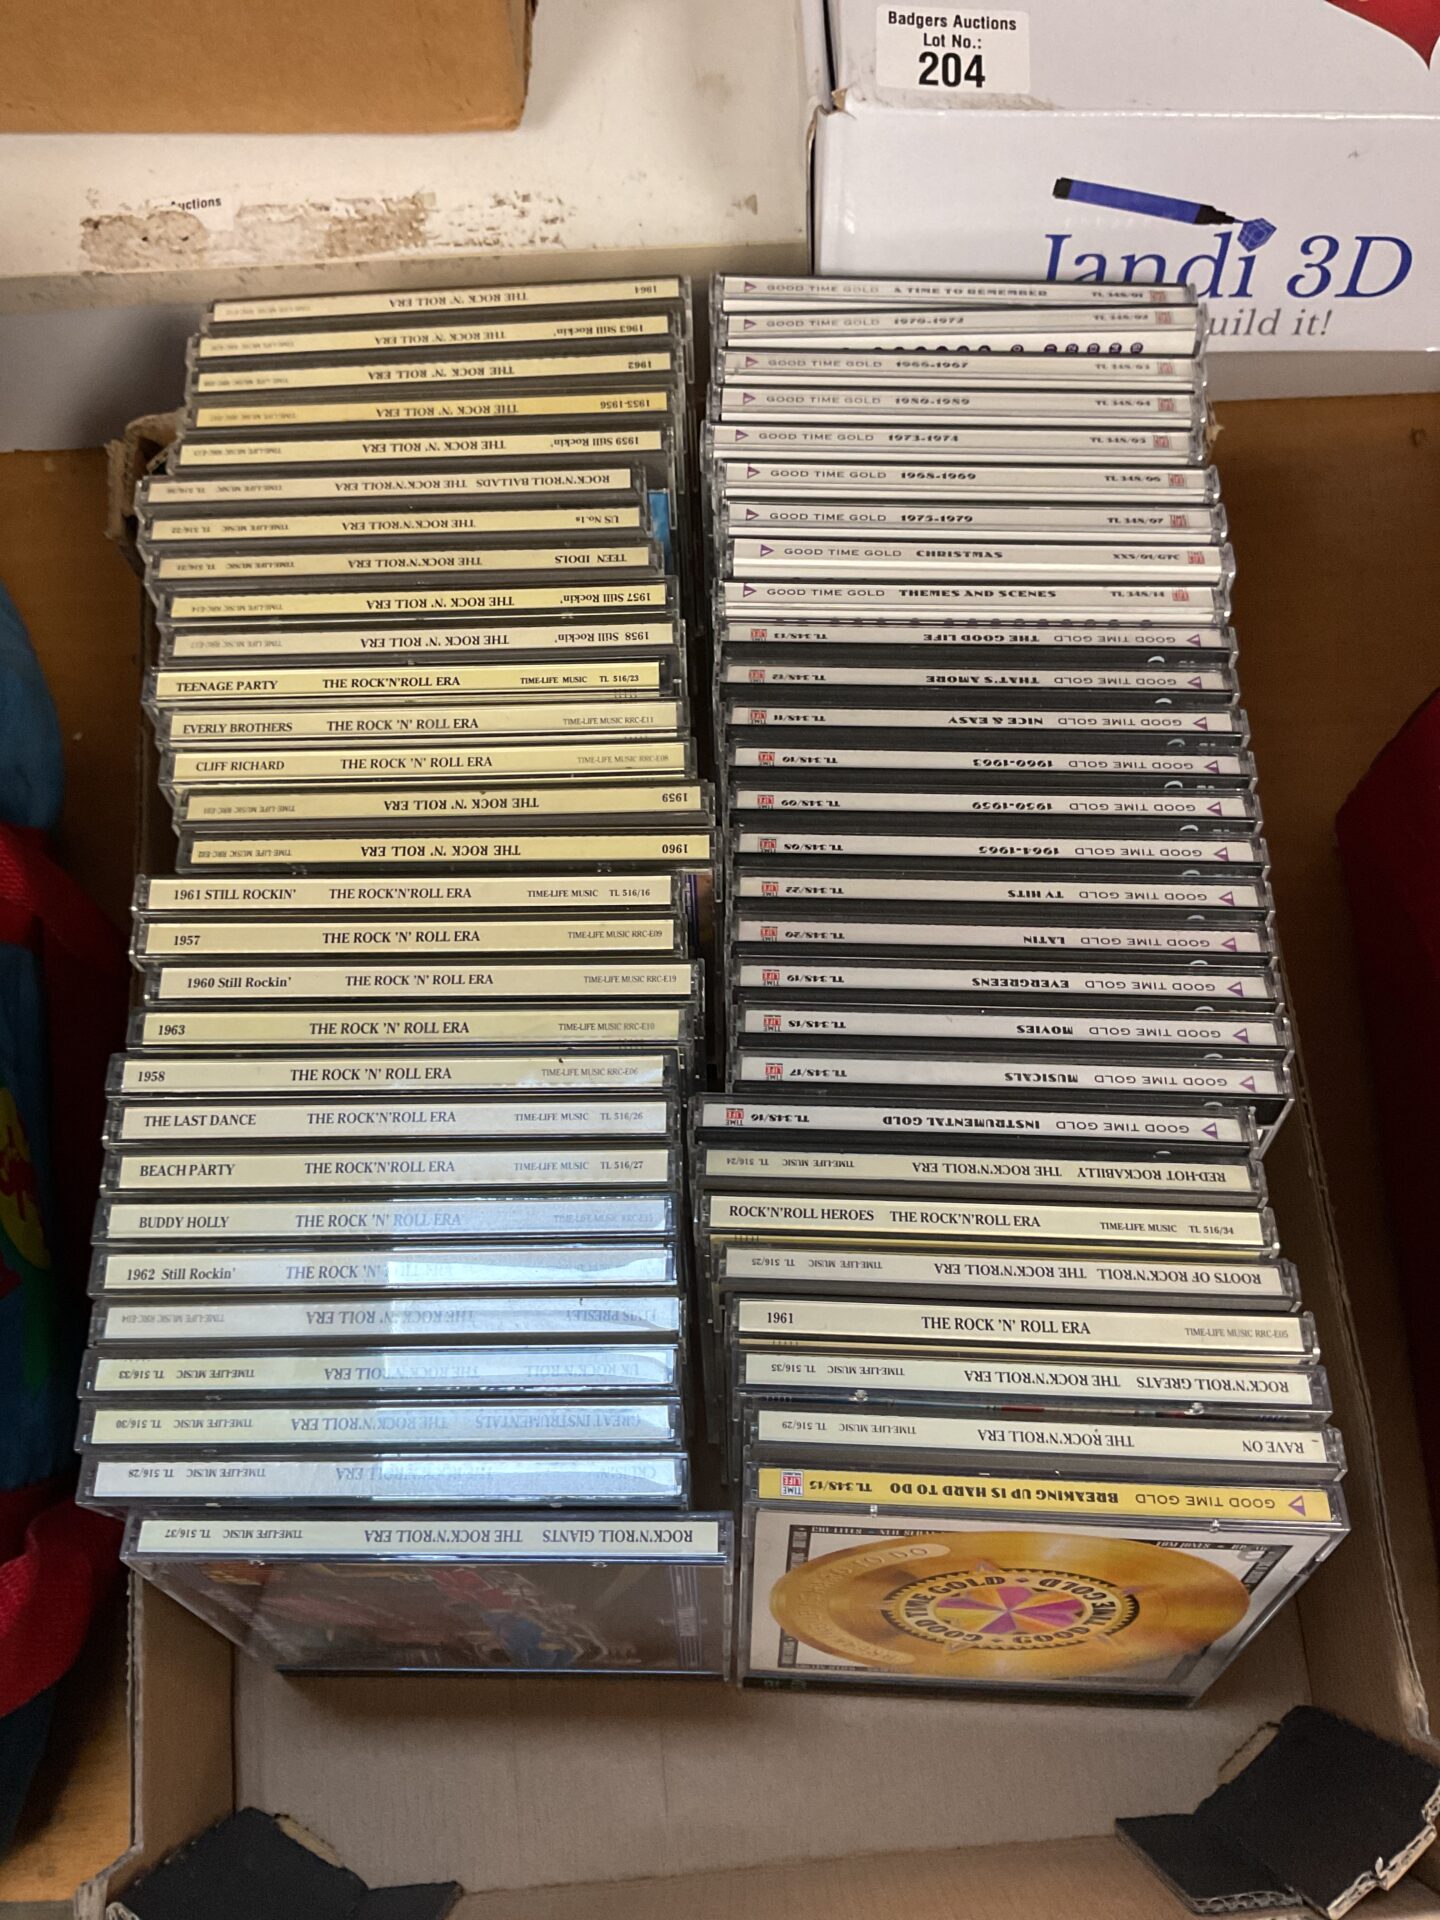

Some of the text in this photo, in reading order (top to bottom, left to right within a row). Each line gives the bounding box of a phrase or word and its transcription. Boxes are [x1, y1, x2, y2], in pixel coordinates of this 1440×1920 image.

[888, 11, 1017, 31] Badgers Auctions
[923, 33, 982, 49] Lot No.:
[918, 51, 986, 88] 204
[1286, 234, 1413, 298] 3D
[1210, 307, 1333, 337] uild it!
[591, 435, 613, 447] Still
[614, 434, 639, 446] 1959
[475, 476, 529, 487] BALLADS
[603, 513, 619, 525] US
[554, 552, 627, 565] TEEN IDOLS
[915, 548, 1003, 559] CHRISTMAS
[602, 592, 624, 603] Still
[626, 591, 650, 602] 1957
[897, 587, 1056, 598] THEMES AND SCENES
[597, 631, 619, 642] Still
[624, 630, 649, 641] 1958
[922, 633, 1039, 643] THE GOOD LIFE
[175, 680, 233, 692] TEENAGE
[235, 679, 278, 691] PARTY
[321, 677, 347, 689] THE
[435, 675, 460, 686] ERA
[519, 674, 559, 685] TIME-LIFE
[561, 674, 588, 684] MUSIC
[598, 673, 609, 684] TL
[925, 673, 979, 684] AMORE
[947, 714, 1043, 726] NICE & EASY
[182, 721, 293, 734] EVERLY BROTHERS
[195, 759, 285, 772] CLIFF RICHARD
[661, 791, 687, 803] 1959
[661, 843, 688, 854] 1960
[174, 888, 200, 900] 1961
[203, 888, 239, 900] STILL
[608, 887, 620, 898] TL
[1006, 888, 1064, 900] TV HITS
[173, 934, 201, 946] 1957
[1022, 934, 1065, 945] LATIN
[187, 976, 215, 988] 1960
[216, 976, 242, 988] Still
[971, 977, 1216, 992] GOOD TIME GOLD EVERGREENS
[157, 1023, 185, 1036] 1963
[1015, 1024, 1073, 1035] MOVIES
[137, 1070, 165, 1082] 1958
[1003, 1071, 1078, 1083] MUSICALS
[143, 1113, 256, 1127] THE LAST DANCE
[881, 1115, 1040, 1129] INSTRUMENTAL GOLD
[139, 1162, 235, 1177] BEACH PARTY
[1076, 1166, 1226, 1182] RED-HOT ROCKABILLY
[138, 1215, 229, 1228] BUDDY HOLLY
[820, 1207, 874, 1221] HEROES
[888, 1210, 918, 1223] THE
[1012, 1214, 1041, 1227] ERA
[1187, 1223, 1201, 1235] TL
[126, 1267, 155, 1281] 1962
[160, 1267, 186, 1280] Still
[1191, 1271, 1210, 1283] OF
[1213, 1272, 1262, 1285] ROOTS
[767, 1311, 793, 1324] 1961
[1135, 1376, 1192, 1390] GREATS
[1241, 1439, 1304, 1454] RAVE ON
[783, 1476, 801, 1486] LIFE
[855, 1481, 872, 1493] TL
[889, 1482, 912, 1494] DO
[916, 1483, 938, 1495] TO
[941, 1484, 987, 1498] HARD
[990, 1486, 1007, 1499] IS
[1010, 1487, 1032, 1500] UP
[1035, 1488, 1118, 1503] BREAKING
[1134, 1492, 1180, 1505] GOLD
[1184, 1495, 1224, 1507] TIME
[1228, 1496, 1275, 1509] GOOD
[198, 1528, 211, 1539] TL
[221, 1528, 254, 1539] MUSIC
[255, 1528, 303, 1539] TIME-LIFE
[542, 1528, 595, 1543] GIANTS
[1039, 1578, 1107, 1601] GOLD
[905, 1576, 1006, 1643] GOOD TIME GOLD
[1012, 1627, 1090, 1643] GOOD
